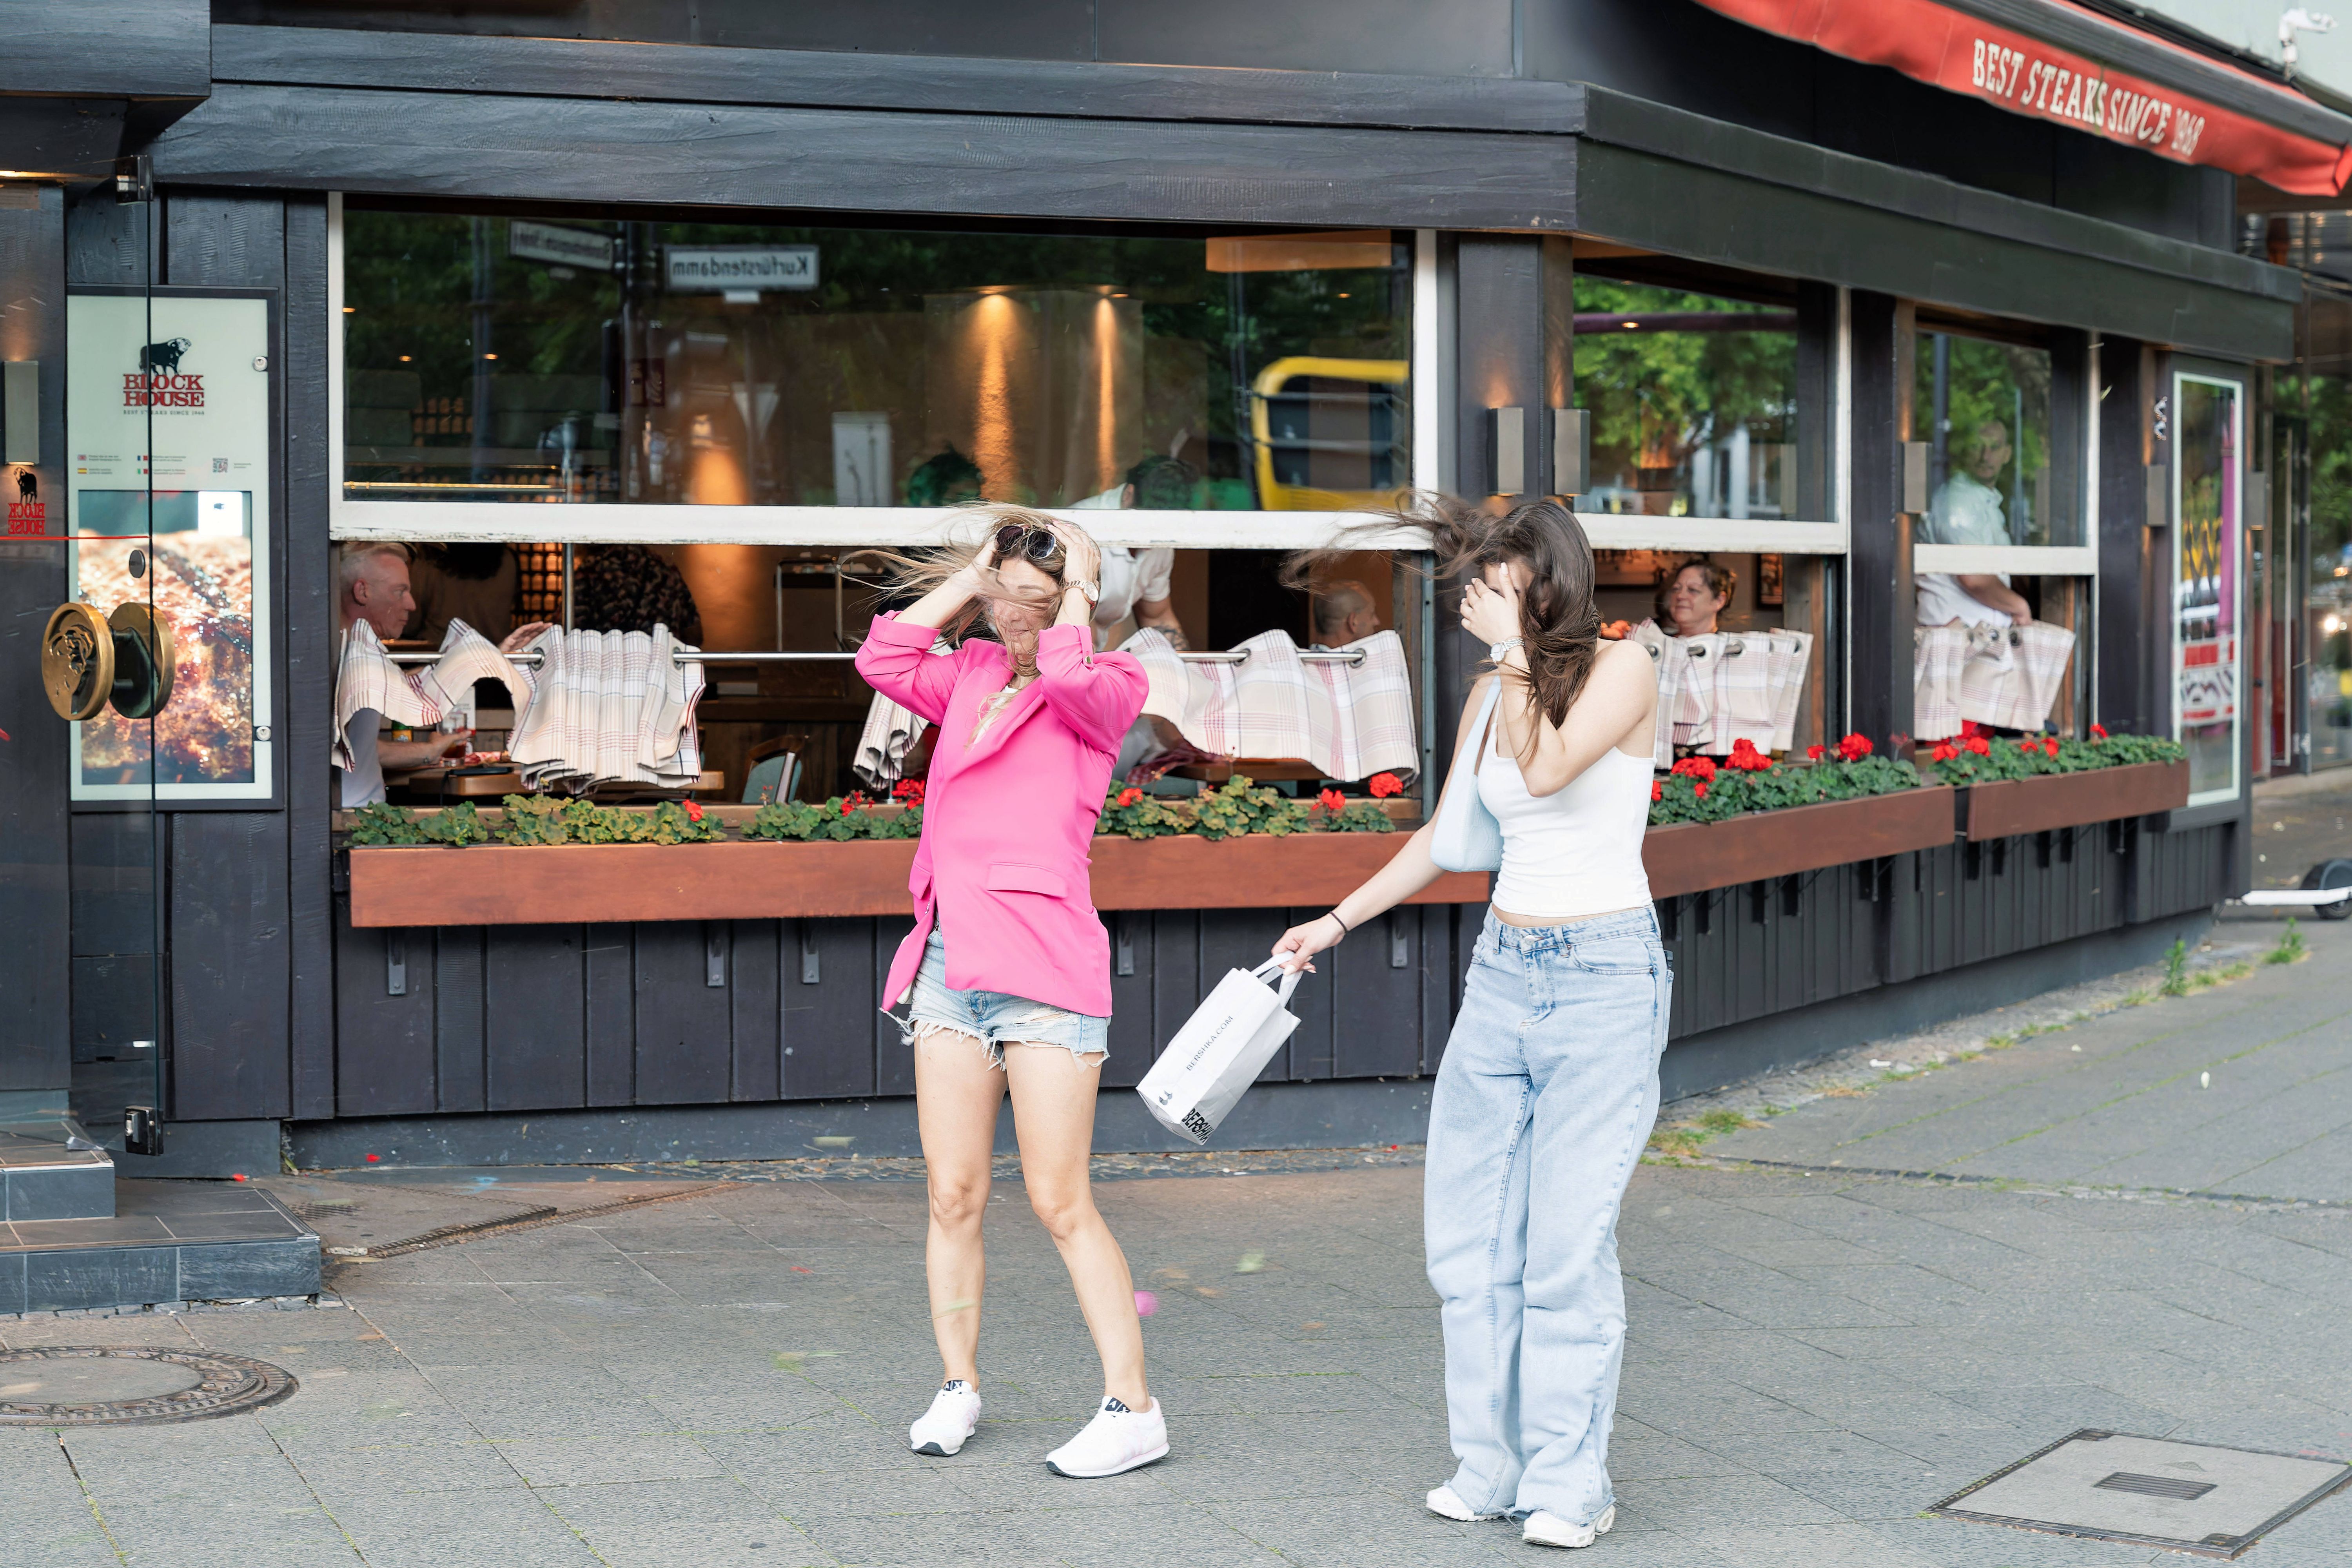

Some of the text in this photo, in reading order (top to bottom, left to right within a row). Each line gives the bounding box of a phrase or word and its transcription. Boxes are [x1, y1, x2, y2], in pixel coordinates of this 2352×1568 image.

[1973, 38, 2025, 98] BEST
[2020, 59, 2109, 127] STEAKS
[2108, 88, 2172, 143] SINCE
[123, 374, 204, 390] BLOCK
[123, 391, 204, 407] HOUSE
[1186, 1016, 1234, 1071] BERSHKA.COM
